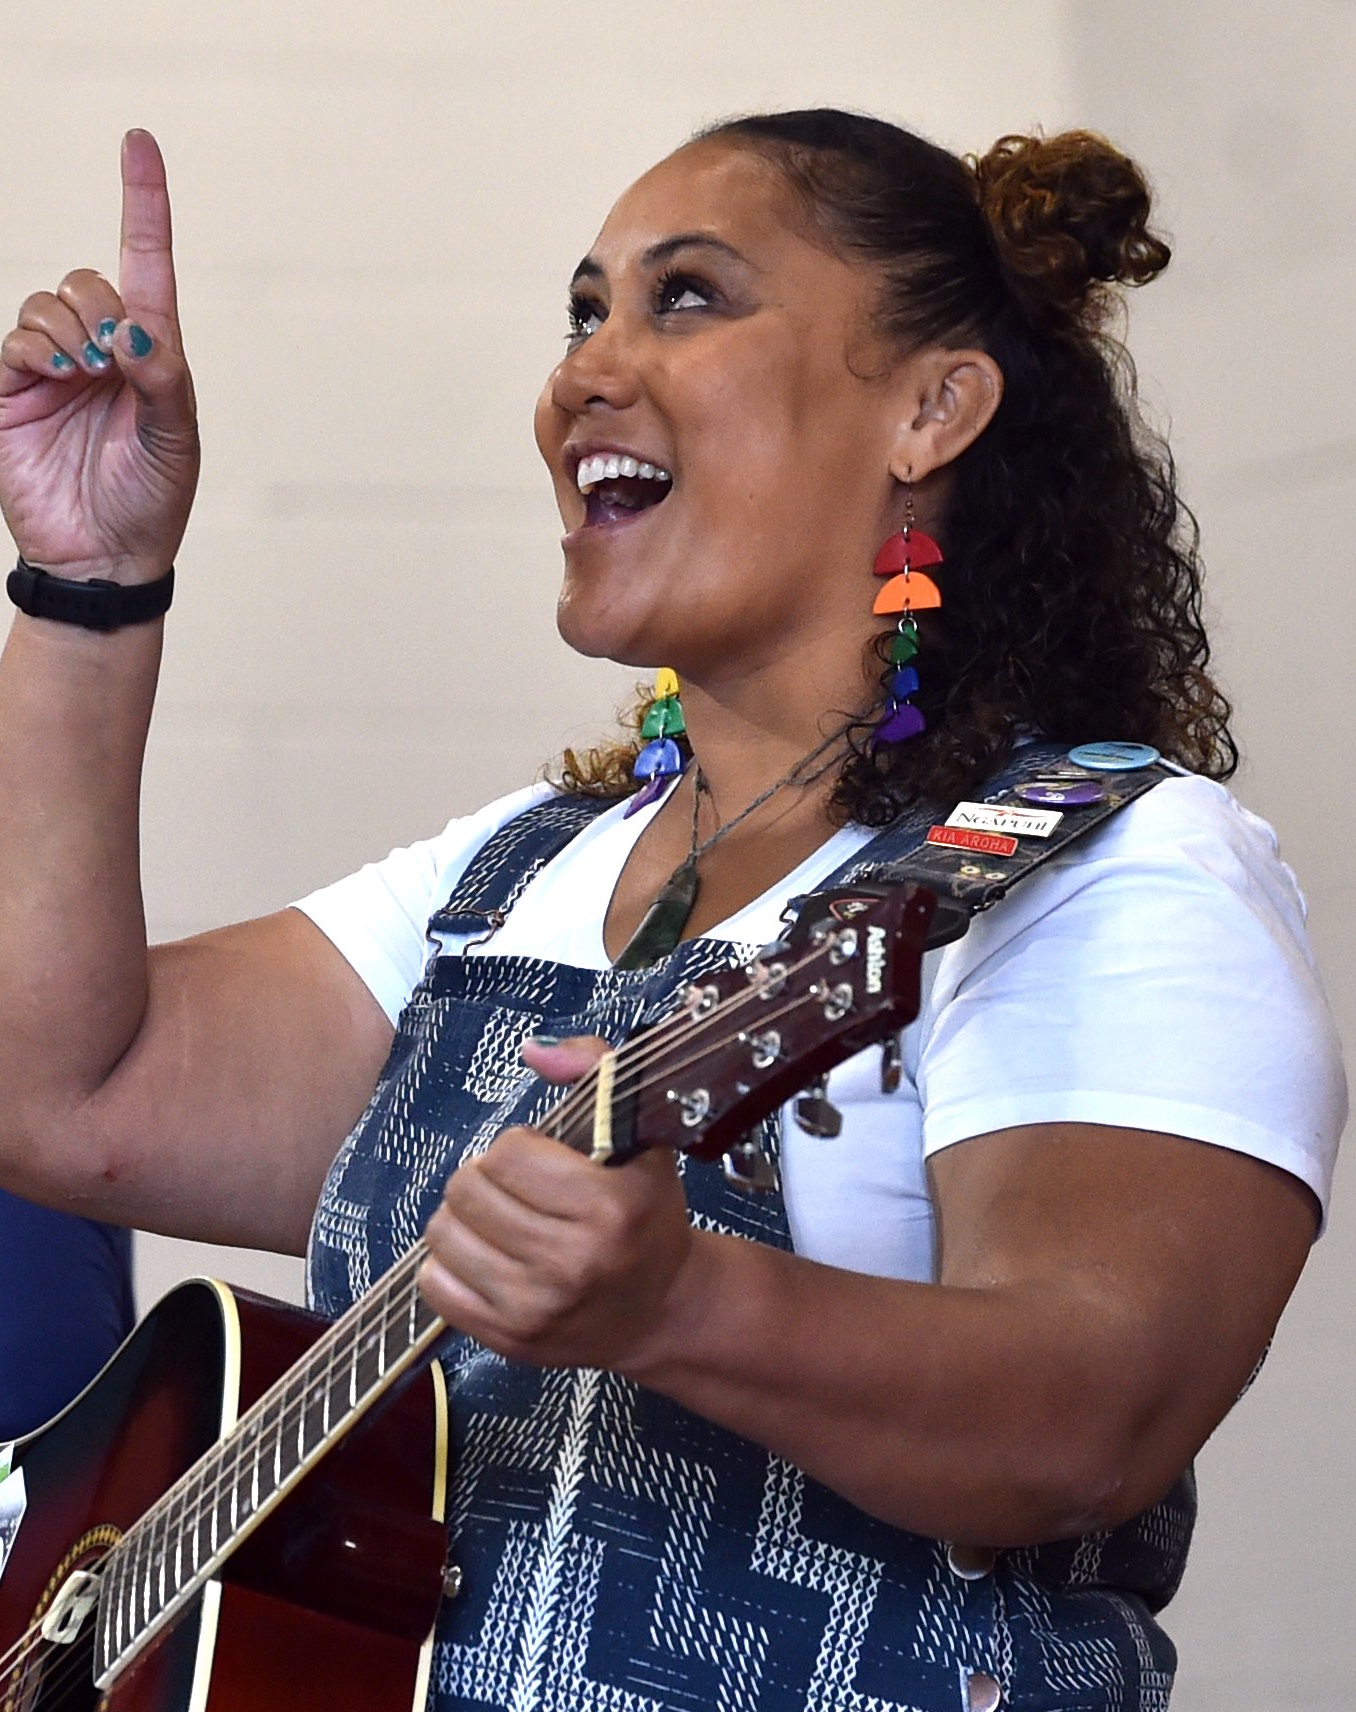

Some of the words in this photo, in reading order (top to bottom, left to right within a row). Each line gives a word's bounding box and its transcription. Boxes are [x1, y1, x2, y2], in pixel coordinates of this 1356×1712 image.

[932, 830, 957, 843] KIA
[961, 834, 1009, 851] AROHA
[866, 926, 886, 994] Ashton
